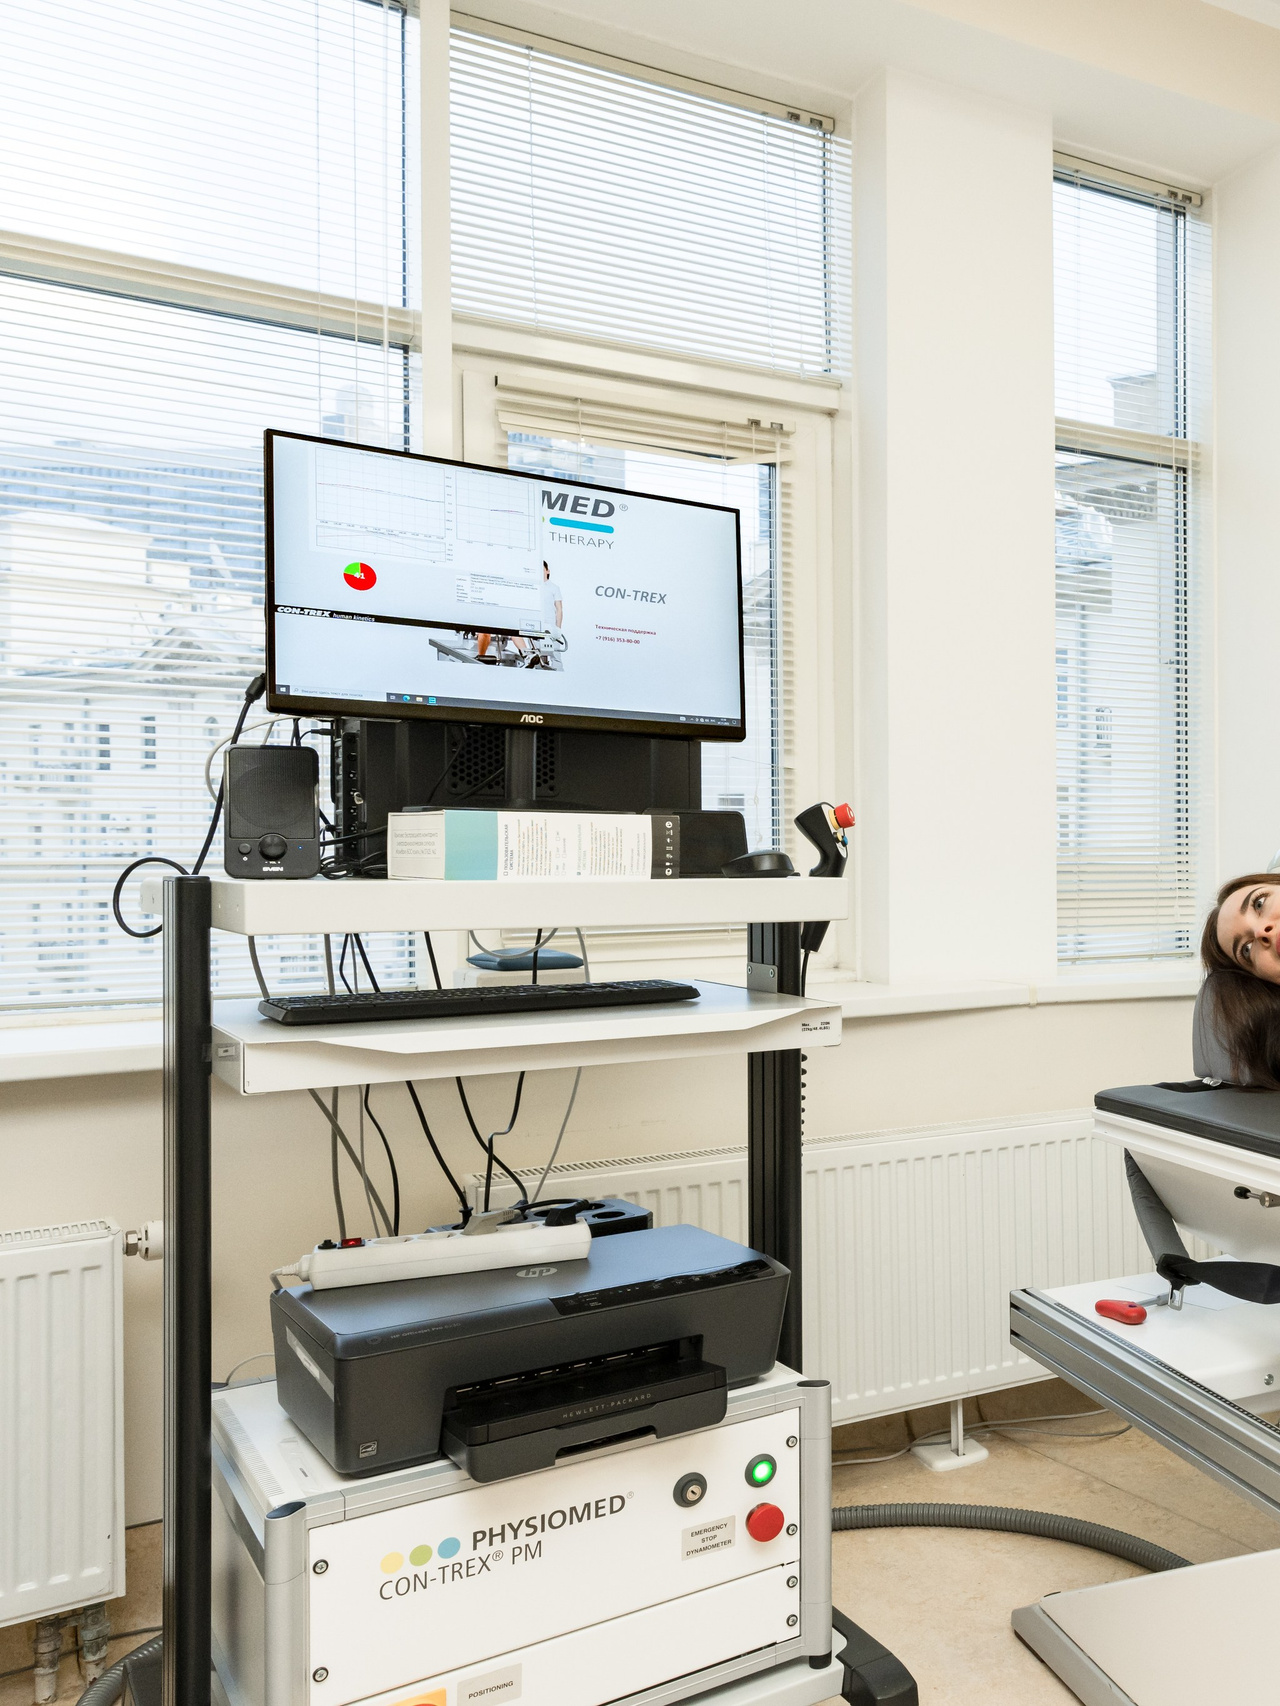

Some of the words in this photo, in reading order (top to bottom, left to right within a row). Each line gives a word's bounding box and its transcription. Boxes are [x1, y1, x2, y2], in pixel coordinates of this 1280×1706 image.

[549, 531, 614, 549] THERAPY
[595, 585, 667, 604] CON-TREX
[277, 606, 331, 618] CON-TREX
[353, 614, 375, 622] kinetics
[595, 624, 627, 632] Техническая
[628, 628, 657, 636] поддержка
[520, 714, 544, 724] AOC
[520, 1267, 555, 1278] hp
[562, 1393, 651, 1418] HEWLETT-PACKARD
[690, 1522, 728, 1537] EMERGENCY
[701, 1534, 718, 1543] STOP
[511, 1540, 543, 1565] PM
[686, 1539, 732, 1556] DYNAMOMETER
[468, 1681, 514, 1699] POSITIONING
